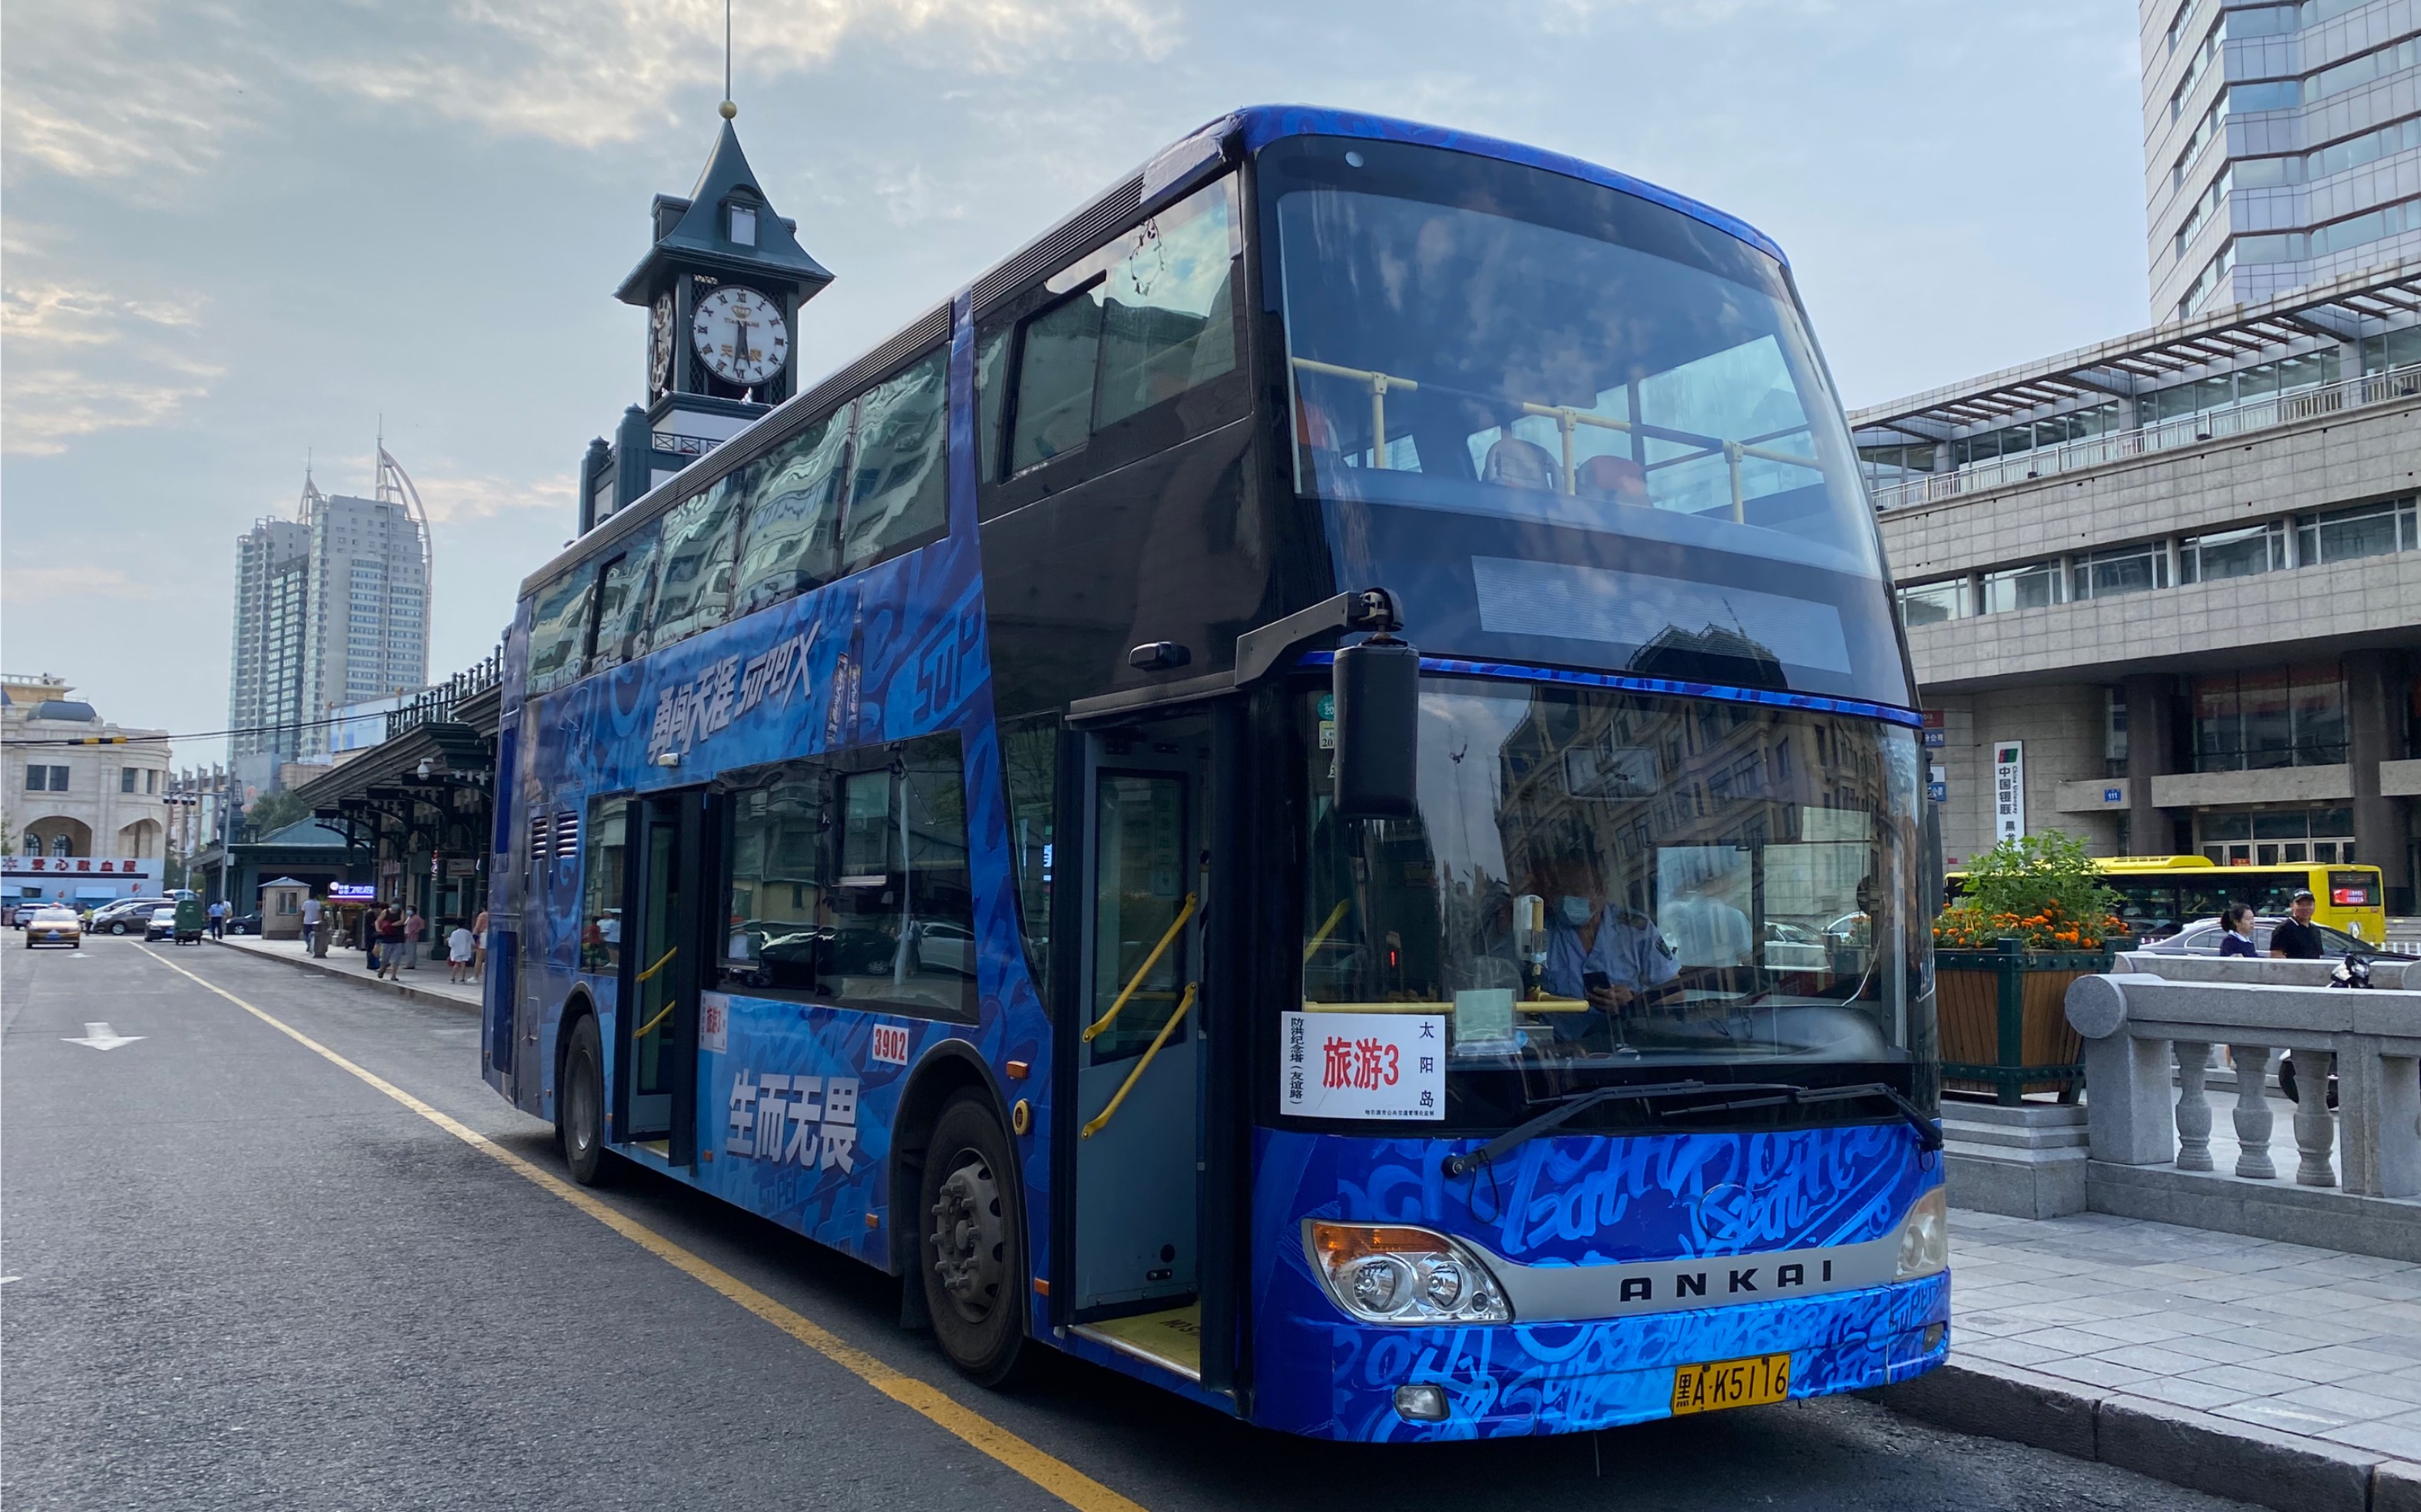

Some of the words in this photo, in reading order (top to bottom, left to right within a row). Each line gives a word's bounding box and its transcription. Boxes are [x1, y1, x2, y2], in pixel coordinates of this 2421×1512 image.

[702, 306, 714, 316] X
[648, 653, 739, 766] 勇闯天涯
[1998, 766, 2013, 816] 中国银联
[874, 1028, 907, 1061] 3902
[1322, 1036, 1400, 1091] 旅游3
[1418, 1021, 1435, 1108] 太阳岛
[726, 1068, 860, 1174] 生而无畏
[1619, 1258, 1834, 1302] ANKAI
